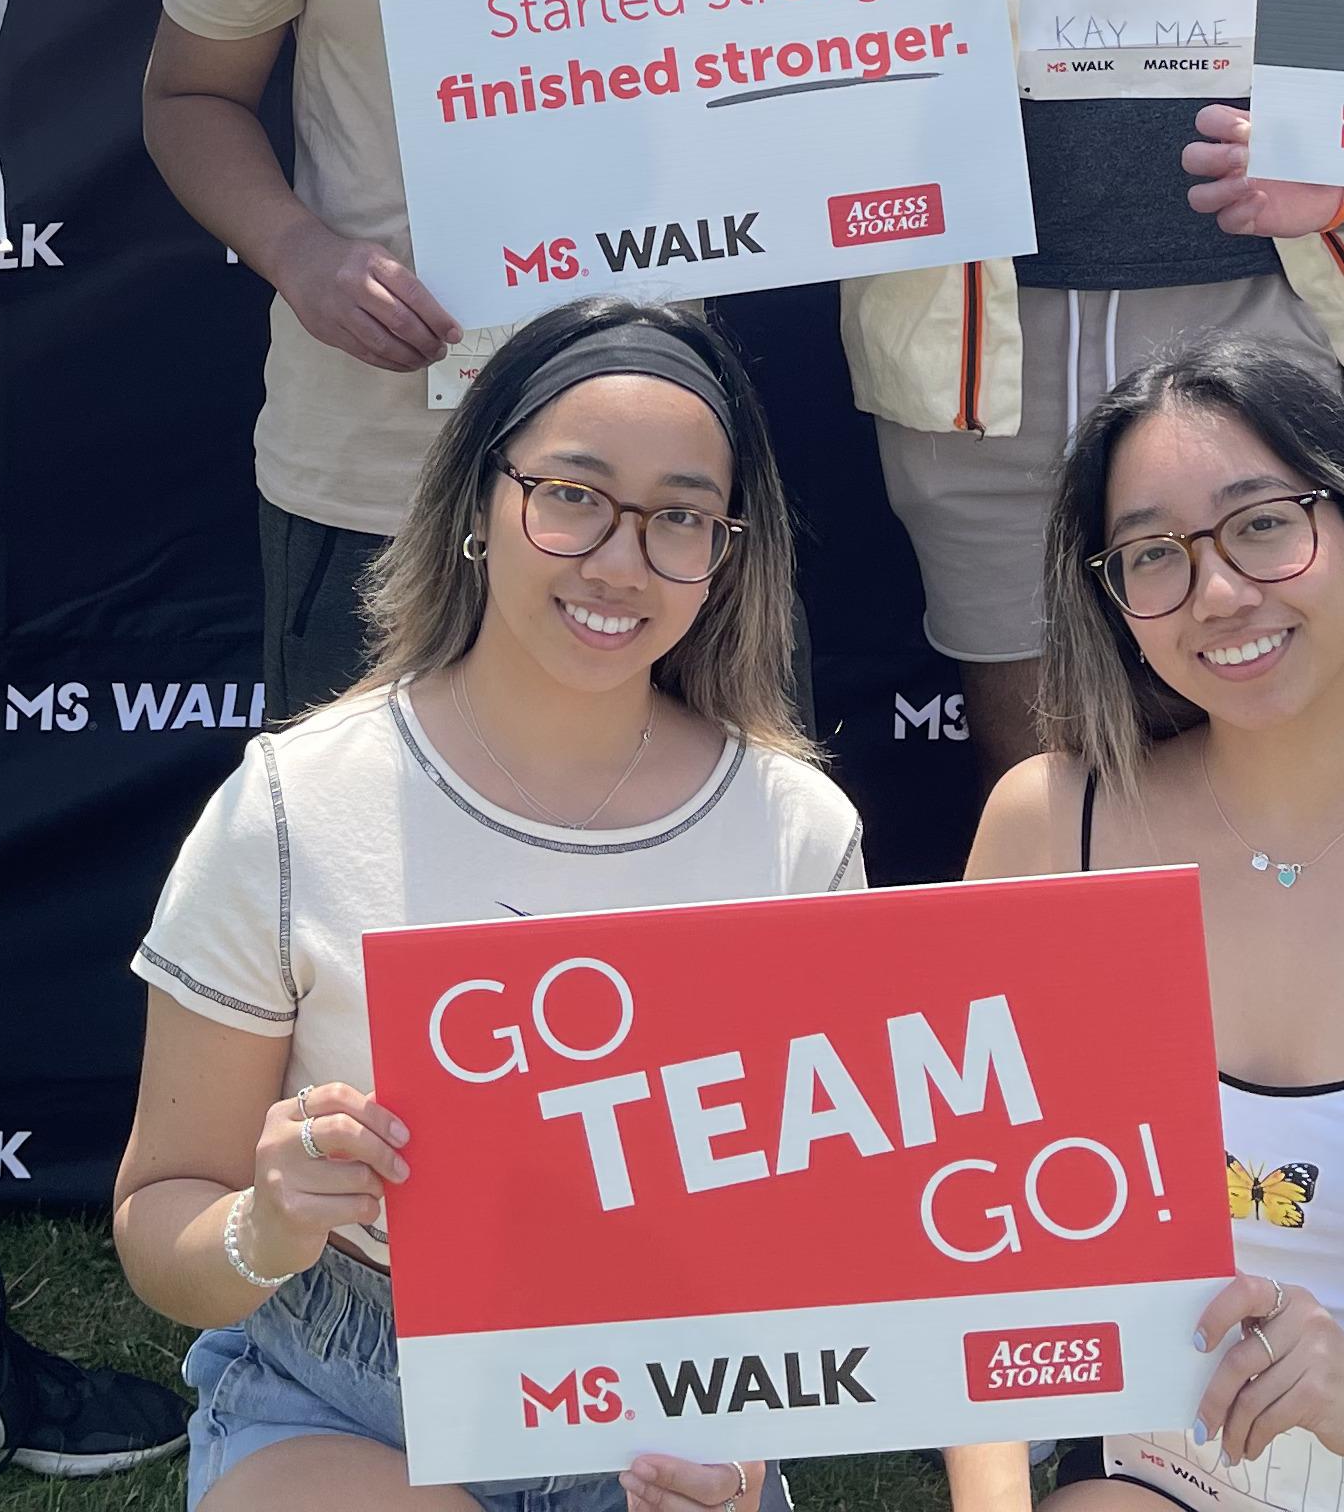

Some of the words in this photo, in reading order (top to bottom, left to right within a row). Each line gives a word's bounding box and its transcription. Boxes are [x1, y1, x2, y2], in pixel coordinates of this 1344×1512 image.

[1055, 15, 1128, 49] KAY
[1156, 18, 1228, 46] MAE
[436, 45, 682, 122] finished
[694, 18, 970, 90] stronger.
[1071, 60, 1115, 72] WALK
[1143, 59, 1209, 70] MARCHE
[1212, 59, 1230, 70] SP
[845, 212, 930, 238] STORAGE
[846, 194, 930, 222] ACCESS
[503, 237, 580, 288] MS
[596, 212, 766, 273] WALK
[6, 682, 89, 732] MS
[428, 956, 635, 1085] GO
[538, 993, 1044, 1213] TEAM
[919, 1122, 1174, 1264] GO!
[987, 1338, 1102, 1366] ACCESS
[987, 1360, 1103, 1388] STORAGE
[520, 1364, 622, 1430] MS
[646, 1345, 876, 1418] WALK
[1170, 1463, 1220, 1502] WALK
